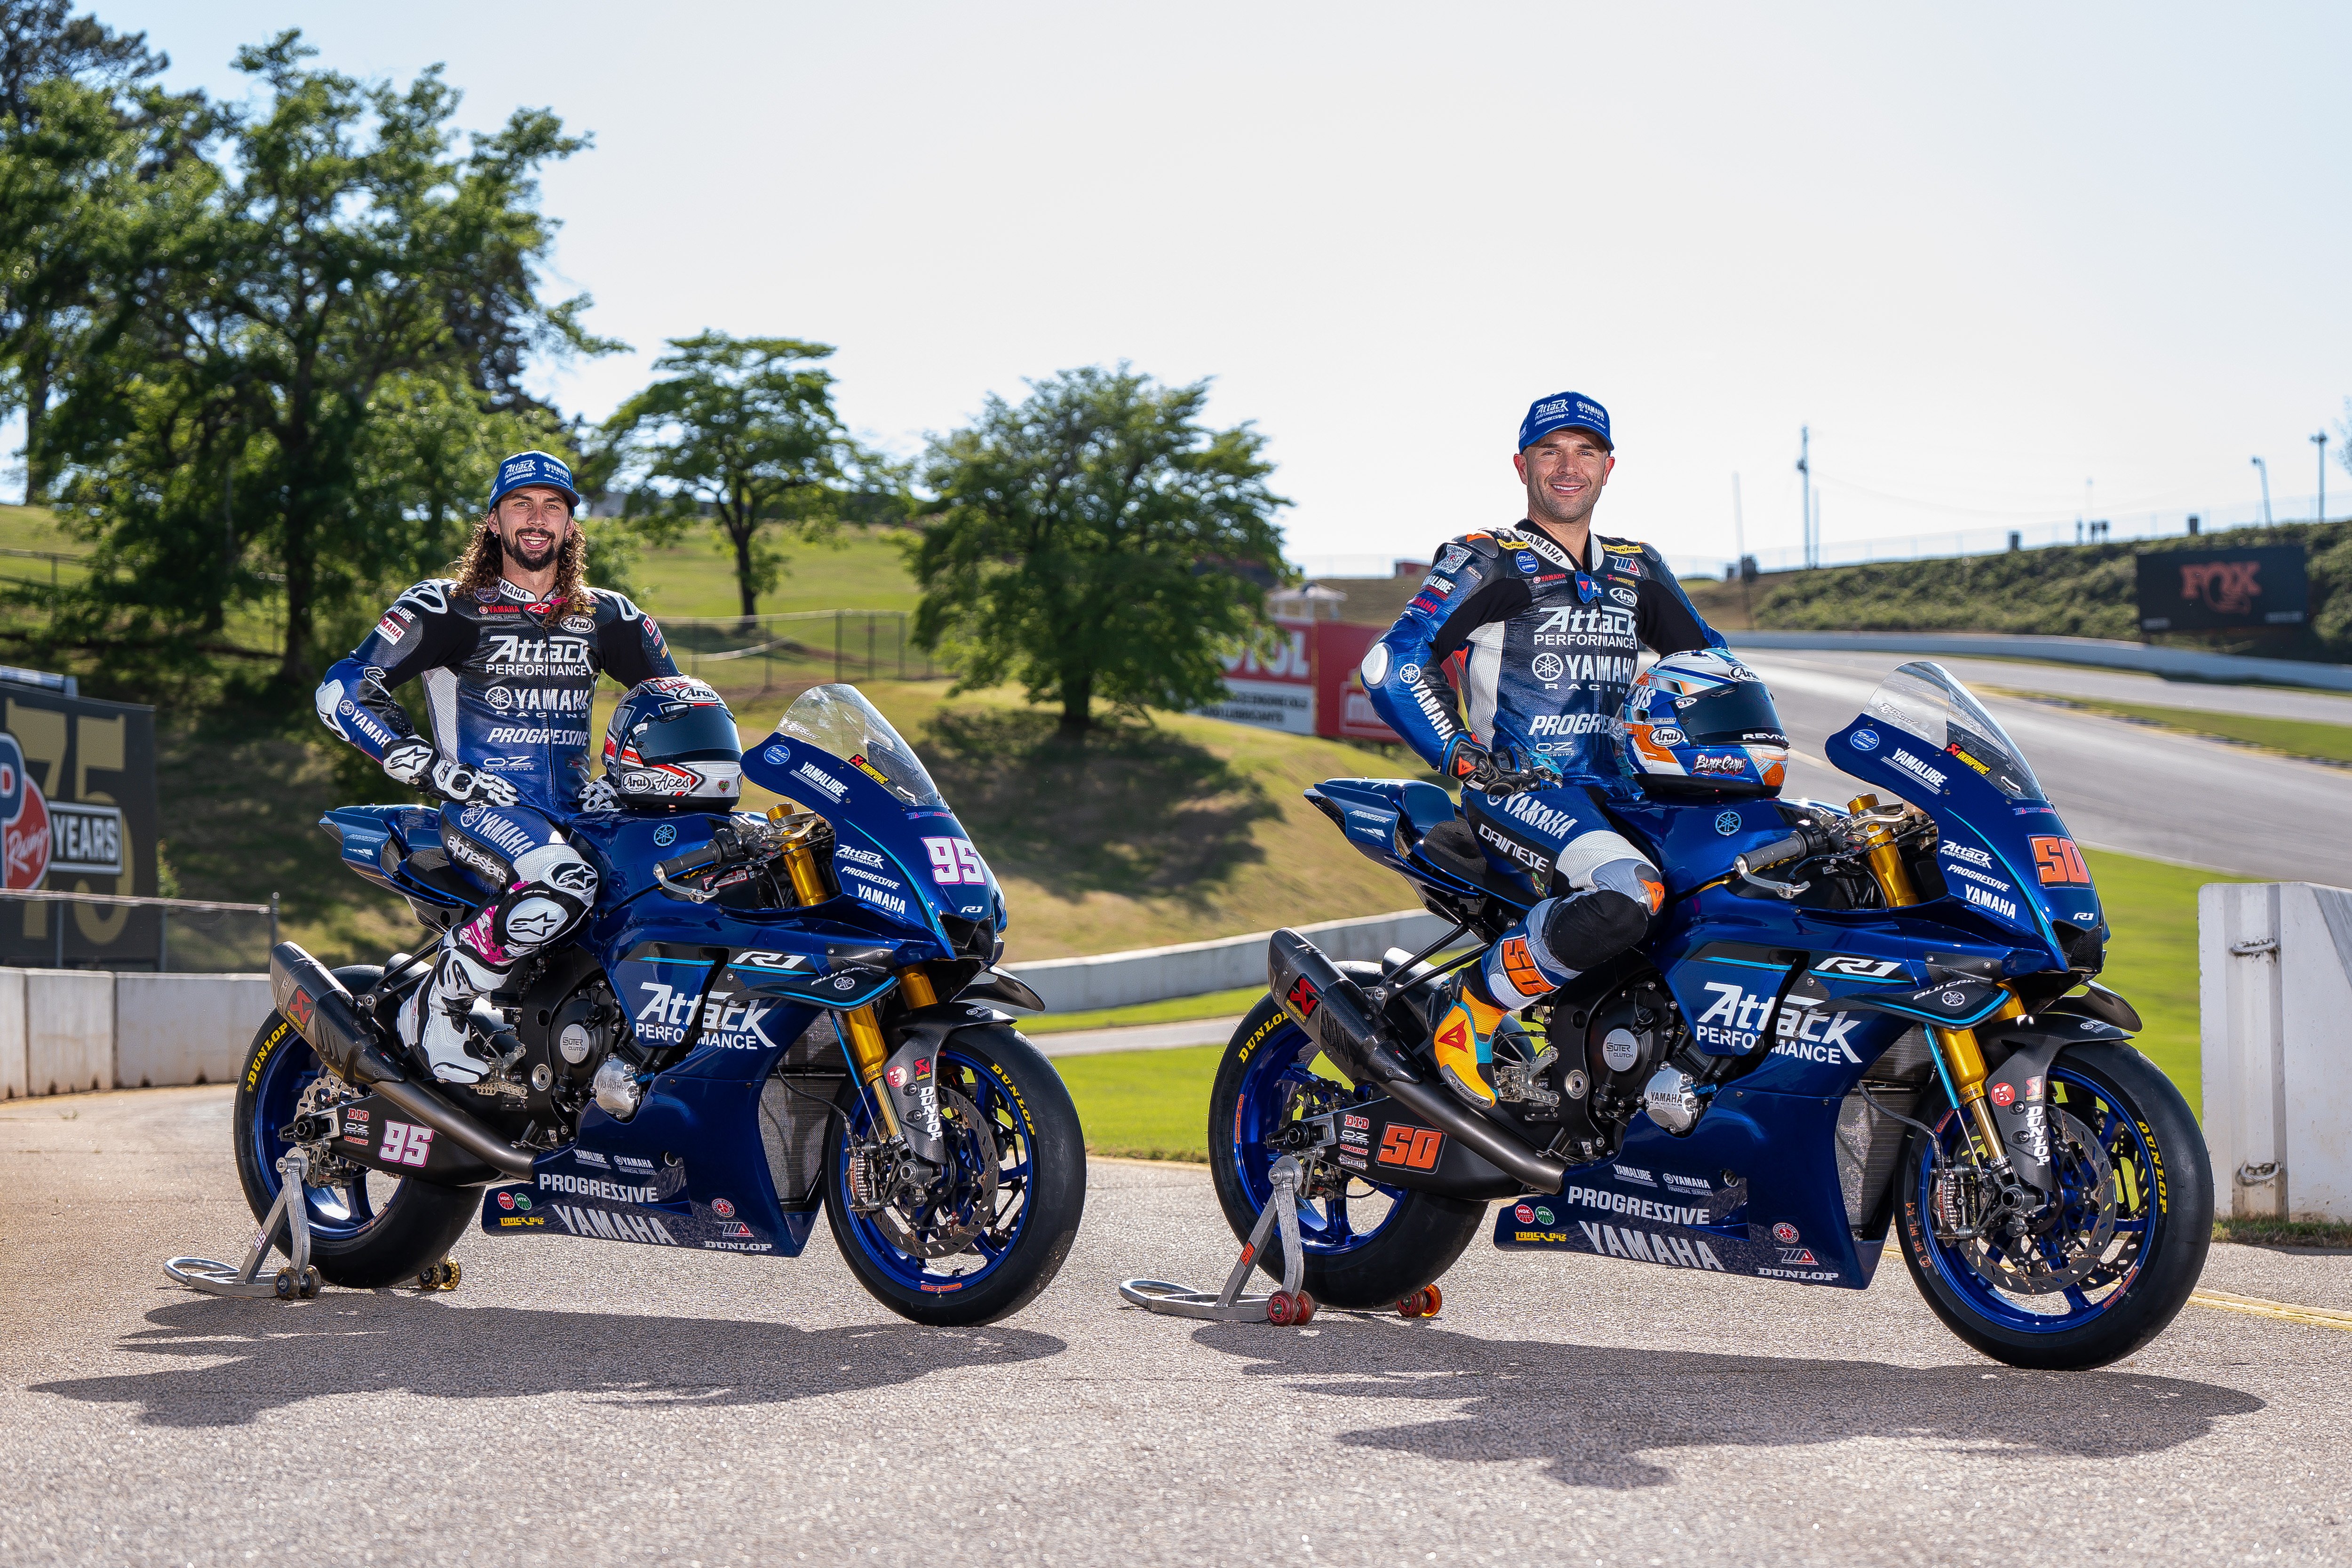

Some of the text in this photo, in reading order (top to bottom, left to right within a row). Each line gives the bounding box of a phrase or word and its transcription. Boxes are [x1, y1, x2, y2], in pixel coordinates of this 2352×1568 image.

[1535, 408, 1565, 421] PERFORMANCE
[1536, 399, 1568, 416] Attack
[1584, 403, 1605, 418] YAMAHA
[505, 460, 536, 476] Attack
[1523, 533, 1563, 563] YAMAHA
[498, 579, 526, 600] MAHA
[1613, 589, 1635, 603] Arai
[380, 618, 402, 639] MAHA
[564, 617, 590, 629] Arai
[1534, 606, 1637, 650] Attack
[1534, 634, 1634, 649] PERFORMANCE
[486, 636, 593, 674] Attack
[681, 688, 715, 700] Arai
[1545, 684, 1629, 694] RACIN
[351, 709, 392, 748] YAMAH
[486, 727, 588, 747] PROGRESSIVE
[1652, 730, 1679, 742] Arai
[1892, 748, 1948, 787] YAMALUBE
[624, 776, 647, 787] Arai
[655, 772, 690, 790] Aces
[800, 762, 848, 797] YAMALUBE
[1350, 810, 1393, 823] PROGRESSIVE
[1504, 792, 1577, 839] YAMAHA
[51, 814, 119, 862] YEARS
[474, 812, 535, 857] YAMAHA
[447, 834, 507, 883] alpinestars
[836, 844, 884, 869] Attack
[1479, 823, 1549, 873] DAINESE
[1940, 840, 1993, 869] Attack
[1940, 849, 1987, 867] PERFORMANCE
[835, 852, 879, 868] PERFORMANCE
[921, 837, 986, 885] 95
[2030, 837, 2090, 883] 50
[841, 866, 900, 890] PROGRESSIVE
[1947, 864, 2010, 892] PROGRESSIVE
[858, 883, 906, 915] YAMAHA
[1965, 884, 2017, 919] YAMAHA
[2073, 912, 2094, 921] R1
[732, 951, 807, 969] R1
[1815, 957, 1903, 977] R1
[636, 982, 777, 1048] Attack
[1697, 981, 1863, 1064] Attack
[562, 1036, 583, 1047] SUTER
[636, 1022, 758, 1050] PERFOMANCE
[1696, 1026, 1841, 1065] PERFOMANCE
[247, 1013, 289, 1086] DUNLOP
[1605, 1042, 1631, 1052] SUTER
[597, 1080, 627, 1092] YAMAHA
[991, 1063, 1036, 1135] DUNLOP
[1650, 1090, 1683, 1104] YAMAHA
[919, 1086, 943, 1142] DUNLOP
[344, 1135, 369, 1146] BRAKING
[379, 1120, 434, 1167] 95
[1377, 1124, 1442, 1169] 50
[2026, 1106, 2050, 1167] DUNLOP
[573, 1149, 607, 1164] YAMALUBE
[1340, 1144, 1369, 1156] BRAKING
[621, 1156, 654, 1169] YAMAHA
[1341, 1155, 1366, 1169] SUPERLITE
[2136, 1121, 2167, 1213] DUNLOP
[1613, 1164, 1652, 1182] YAMALUBE
[1673, 1175, 1711, 1189] YAMAHA
[539, 1173, 659, 1203] PROGRESSIVE
[1668, 1186, 1692, 1194] FINANCIAL
[1568, 1186, 1710, 1225] PROGRESSIVE
[552, 1204, 678, 1245] YAMAHA
[704, 1241, 772, 1251] DUNLOP
[1578, 1221, 1725, 1271] YAMAHA
[1757, 1268, 1839, 1281] DUNLOP
